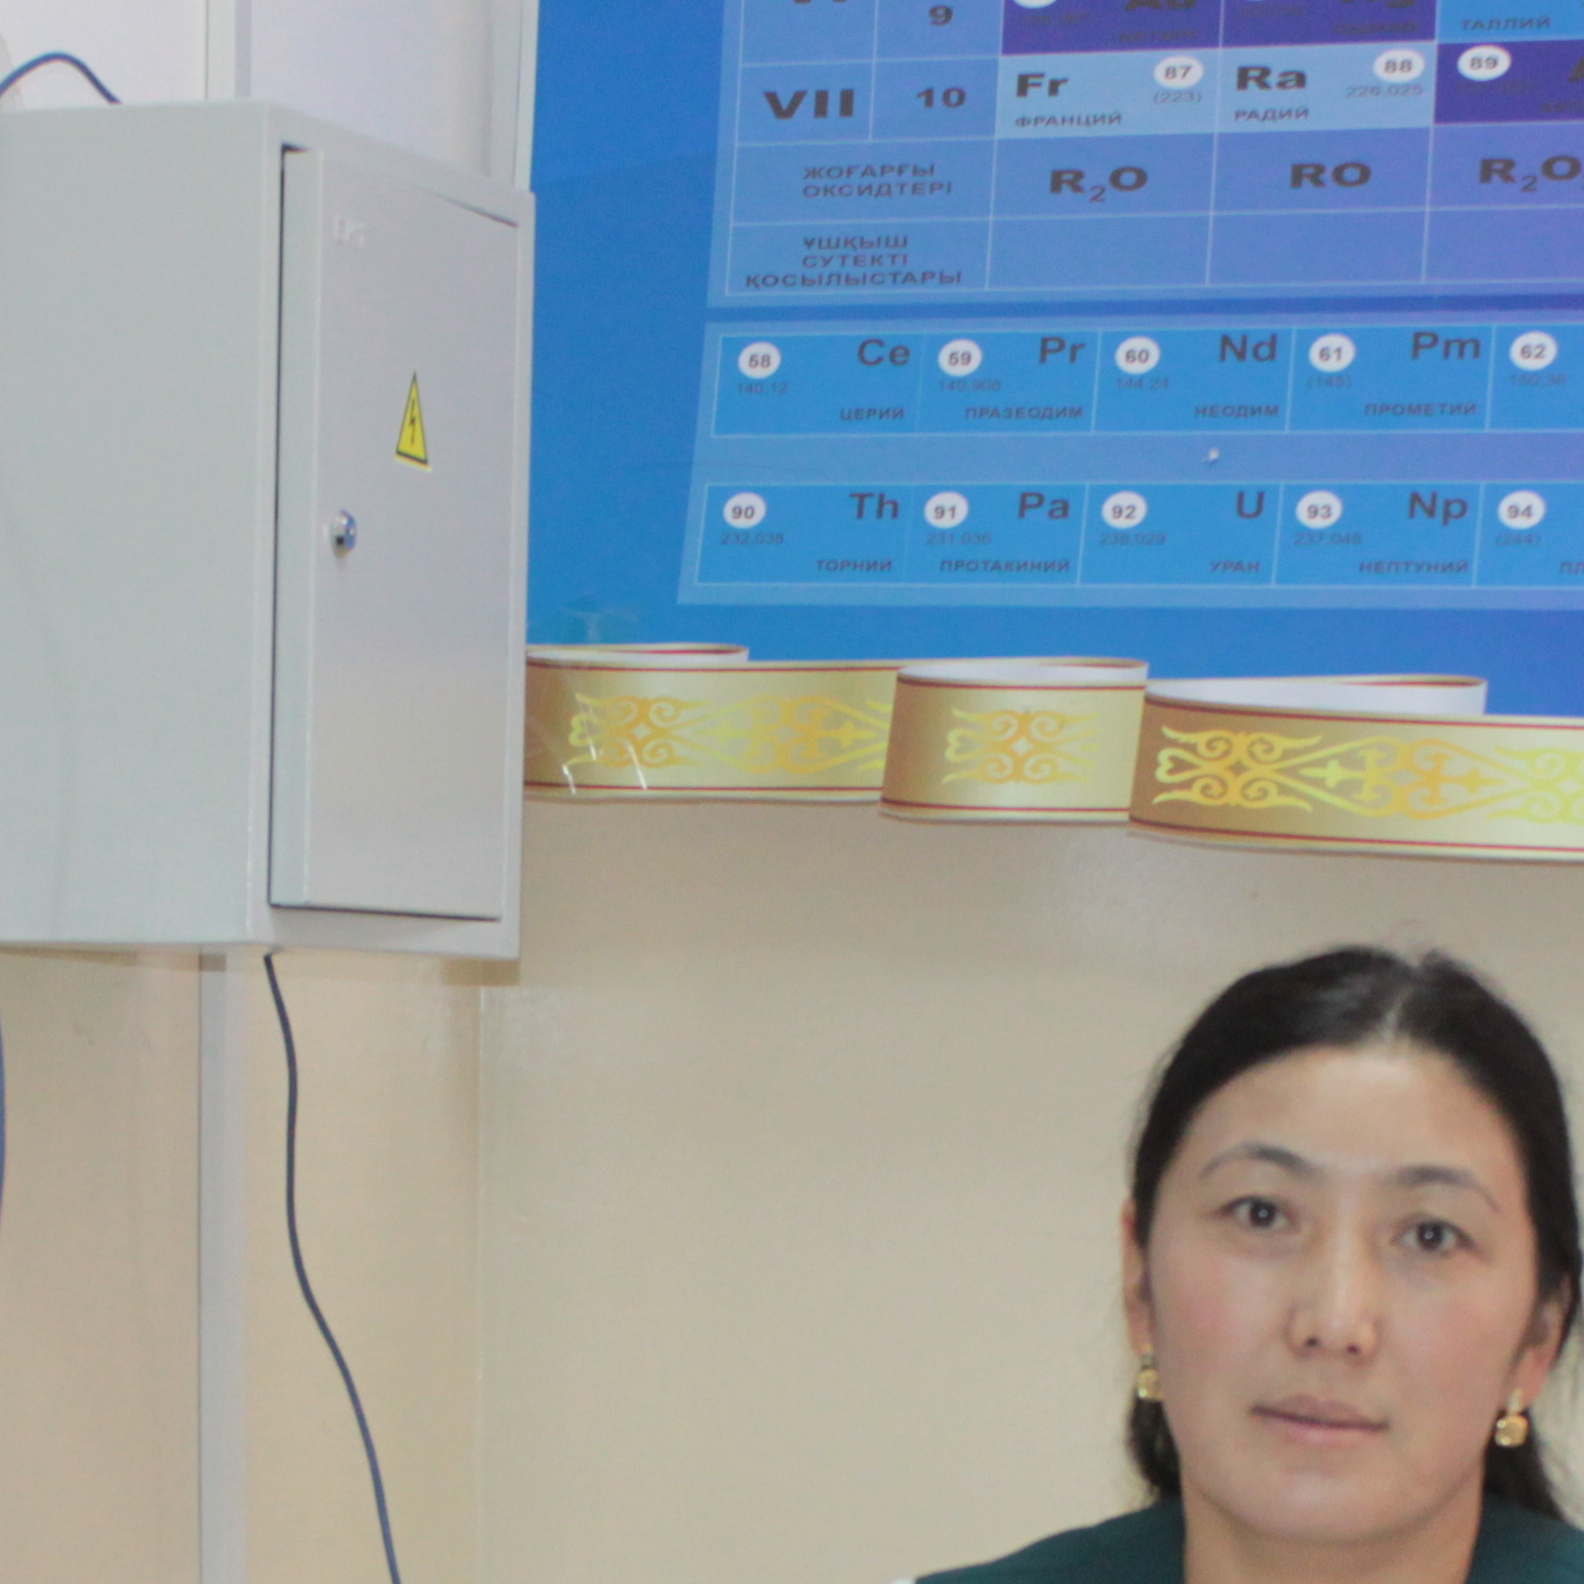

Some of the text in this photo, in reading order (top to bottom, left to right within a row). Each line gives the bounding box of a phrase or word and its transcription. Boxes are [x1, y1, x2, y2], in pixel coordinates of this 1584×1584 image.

[928, 6, 953, 25] 9
[1461, 15, 1551, 31] ТАЛЛИЙ
[1384, 59, 1412, 73] 88
[1470, 57, 1497, 70] 89
[1164, 66, 1192, 79] 87
[1237, 65, 1307, 91] Ra
[1017, 73, 1069, 97] Fr
[763, 89, 856, 119] VII
[916, 87, 966, 108] 10
[1015, 112, 1122, 127] ФРАНЦИЙ
[1235, 107, 1309, 122] РАДИЙ
[803, 163, 936, 180] ЖОҒАРҒЫ
[1290, 162, 1371, 188] RO
[802, 182, 952, 199] ОКСИДТЕРІ
[802, 254, 908, 269] СУТЕКТІ
[746, 271, 962, 289] ҚОСЫЛЫСТАРЫ
[857, 338, 911, 367] Ce
[1038, 336, 1086, 364] Pr
[1219, 333, 1278, 363] Nd
[1411, 330, 1482, 361] Pm
[1520, 344, 1545, 359] 62
[748, 355, 771, 367] 58
[948, 352, 971, 365] 59
[1126, 351, 1149, 363] 60
[1320, 348, 1342, 361] 61
[840, 406, 905, 423] ЦЕРИЙ
[965, 405, 1084, 420] ПРАЗЕОДИМ
[1195, 404, 1280, 420] НЕОДИМ
[1364, 402, 1477, 416] ПРОМЕТИЙ
[732, 506, 755, 519] 90
[849, 492, 899, 520] Th
[934, 506, 957, 519] 91
[1018, 492, 1070, 520] Pa
[1113, 506, 1135, 519] 92
[1236, 491, 1266, 519] U
[1307, 506, 1331, 519] 93
[1407, 491, 1468, 526] Np
[1508, 505, 1532, 518] 94
[1210, 561, 1260, 573] УРАН
[1359, 559, 1468, 574] НЕПТУНИЙ
